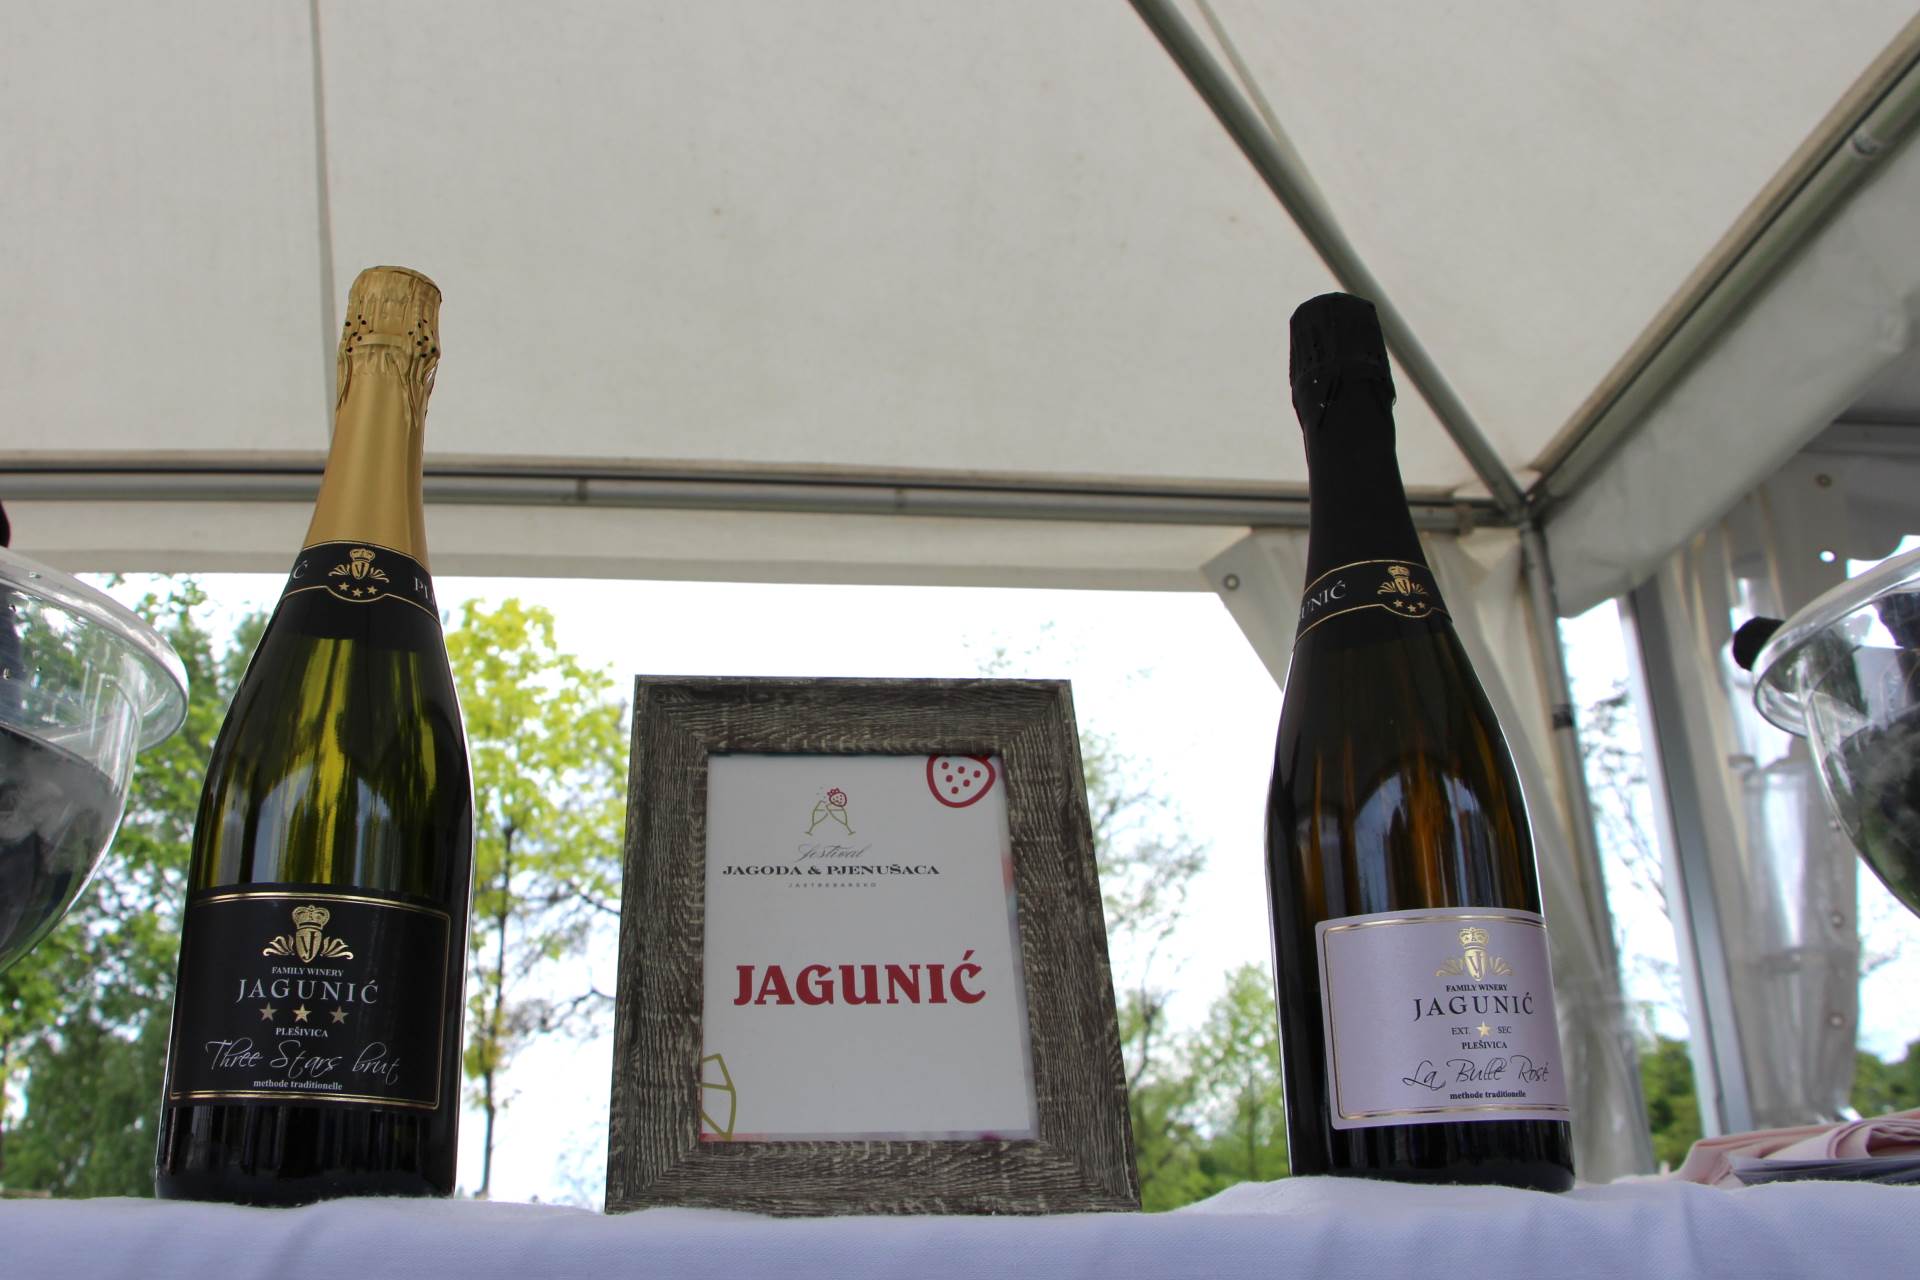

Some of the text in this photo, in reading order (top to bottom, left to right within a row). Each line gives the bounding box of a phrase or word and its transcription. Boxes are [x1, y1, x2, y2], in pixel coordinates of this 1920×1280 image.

[722, 863, 940, 876] JAGODA & PJENUŠACA
[271, 966, 344, 977] FAMILY WINERY
[733, 950, 987, 1006] JAGUNIĆ
[236, 978, 379, 1004] JAGUNIĆ
[1446, 983, 1508, 993] FAMILY WINERY
[1413, 992, 1534, 1021] JAGUNIĆ
[275, 1026, 329, 1038] PLEŠIVICA
[1497, 1026, 1512, 1034] SEC
[1461, 1040, 1508, 1050] PLEŠIVICA
[205, 1037, 400, 1085] Three Stars brut
[1402, 1060, 1447, 1092] La
[1446, 1057, 1507, 1083] Bulle
[253, 1079, 343, 1091] methode traditionelle
[1449, 1090, 1526, 1100] methode traditionelle
